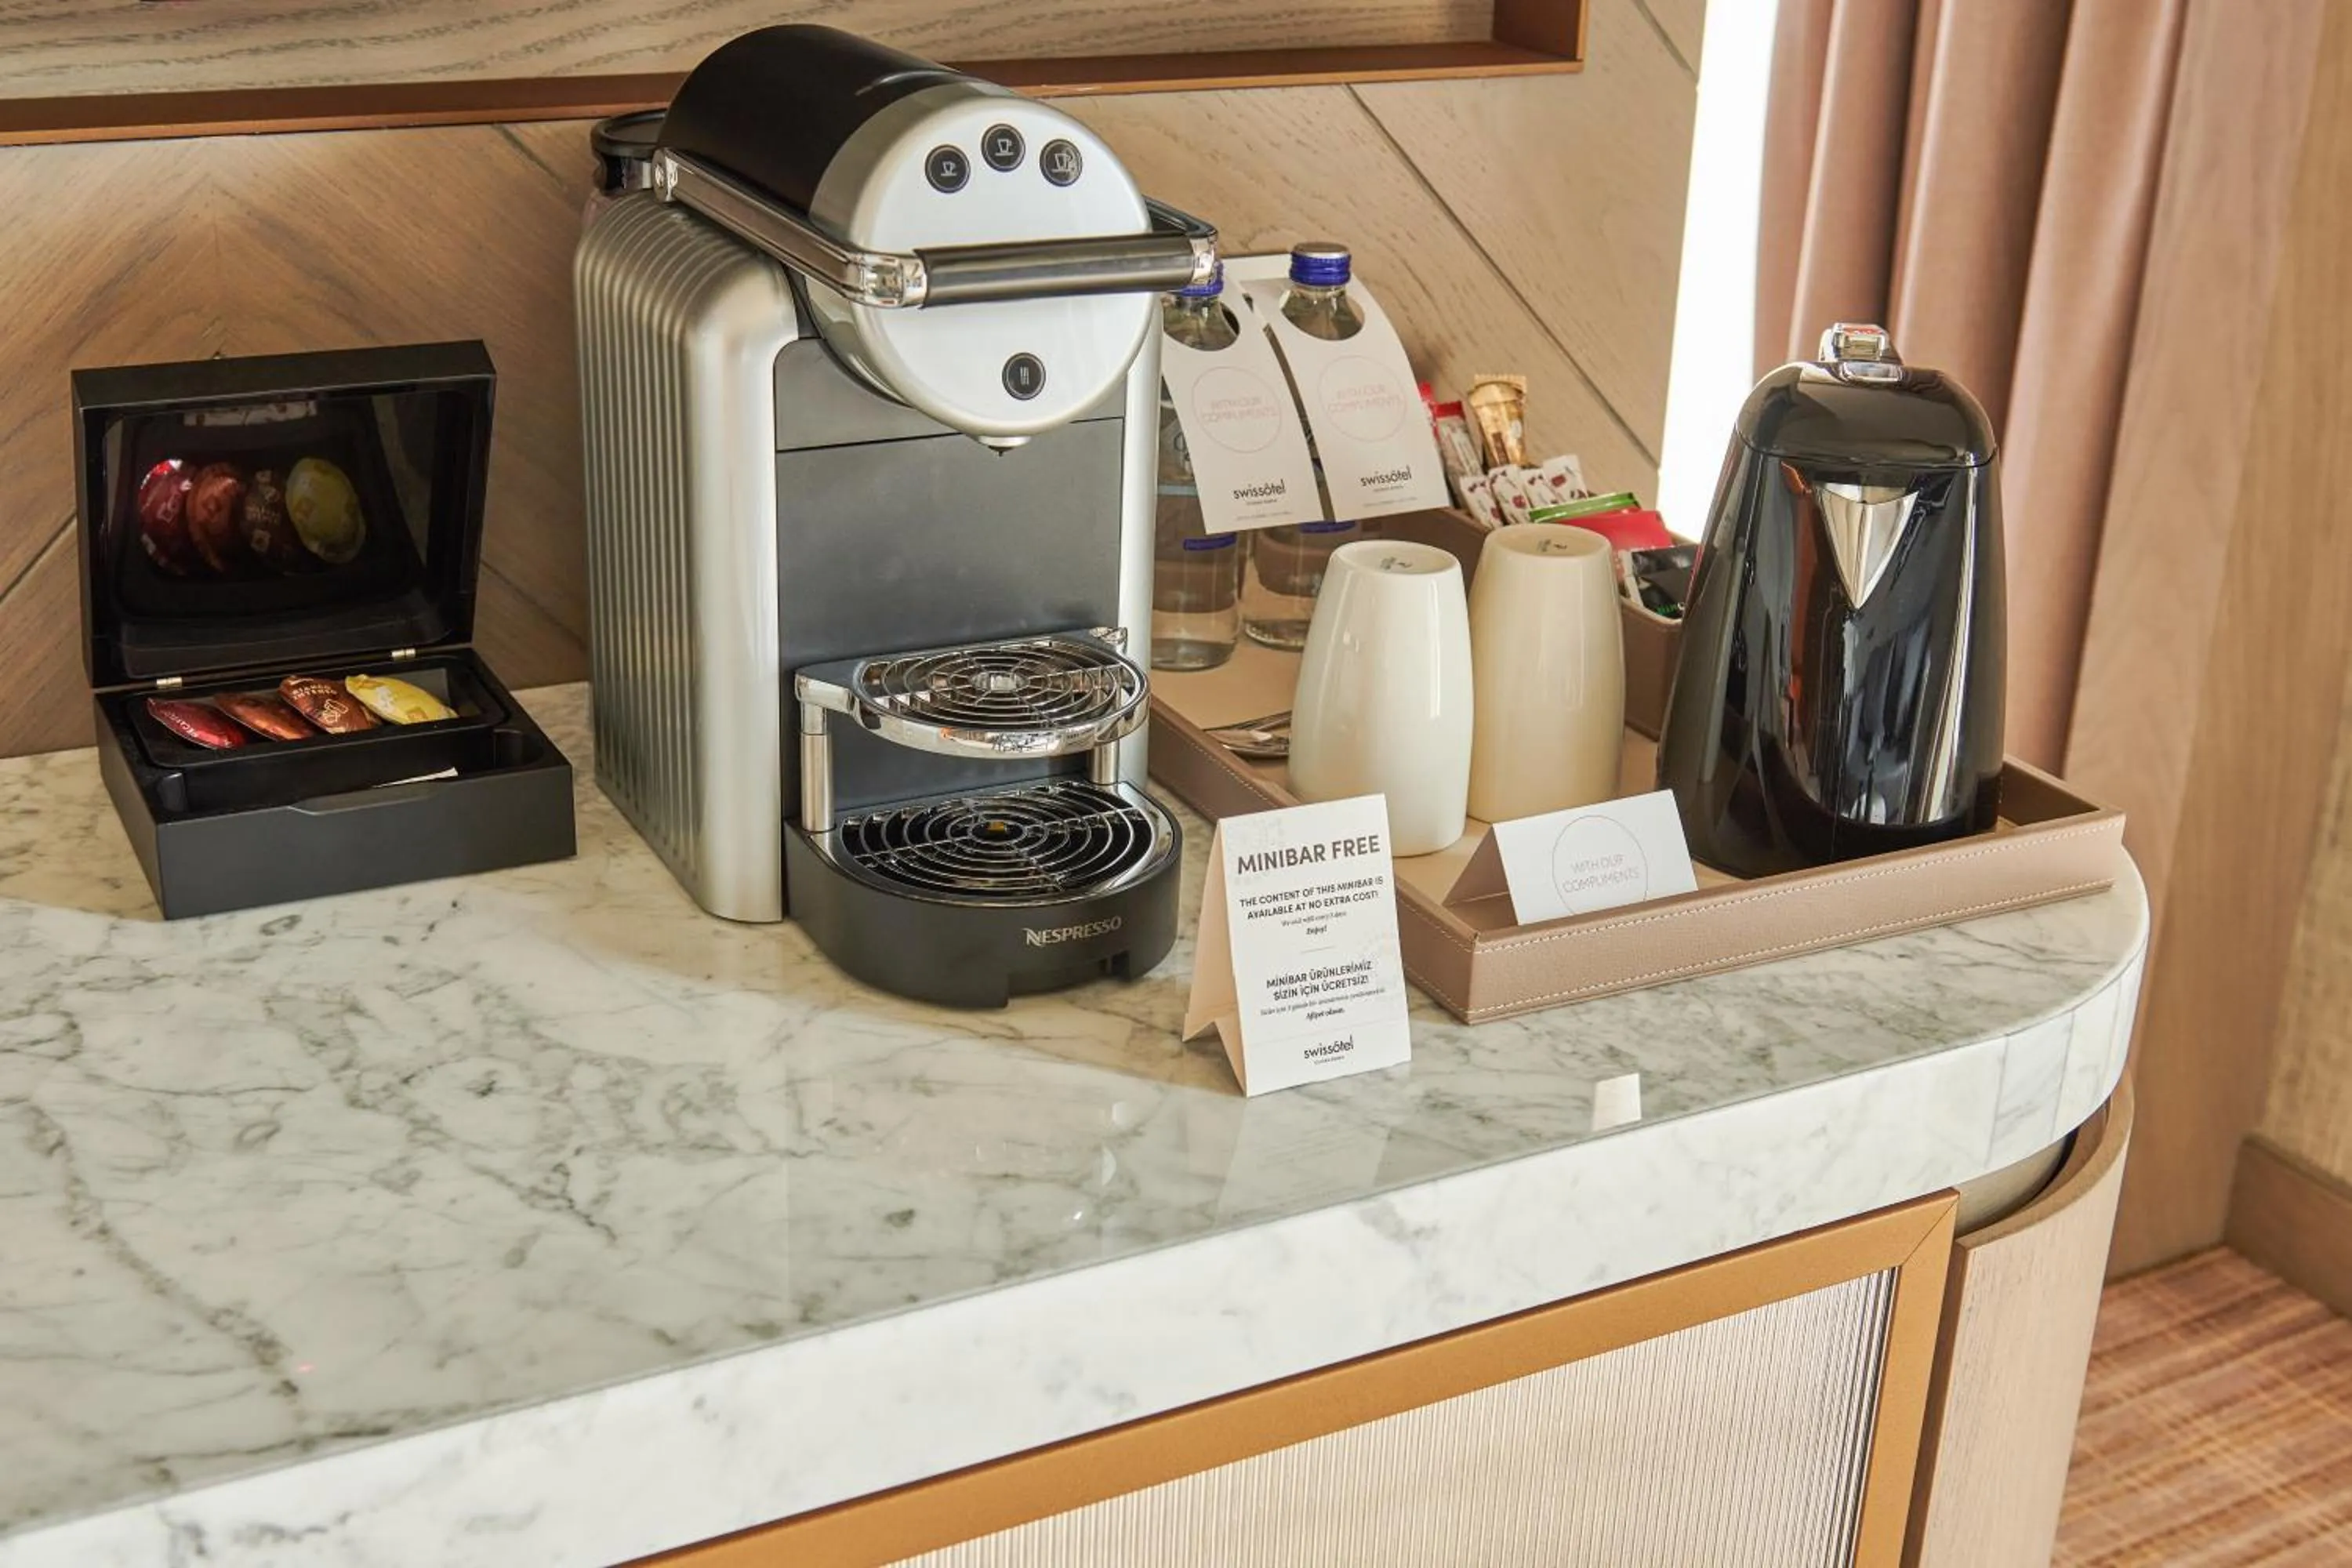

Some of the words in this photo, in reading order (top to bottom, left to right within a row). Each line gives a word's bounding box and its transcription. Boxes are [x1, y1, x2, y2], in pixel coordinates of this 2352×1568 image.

[1237, 844, 1327, 875] MINIBAR
[1332, 835, 1381, 859] FREE
[1240, 896, 1258, 908] THE
[1259, 890, 1301, 905] CONTENT
[1302, 887, 1315, 898] OF
[1316, 884, 1335, 895] THIS
[1337, 878, 1374, 892] MINIBAR
[1374, 876, 1384, 885] IS
[1247, 904, 1294, 920] AVAILABLE
[1295, 902, 1306, 912] AT
[1308, 899, 1322, 909] NO
[1324, 895, 1351, 907] EXTRA
[1022, 916, 1122, 947] NESPRESSO
